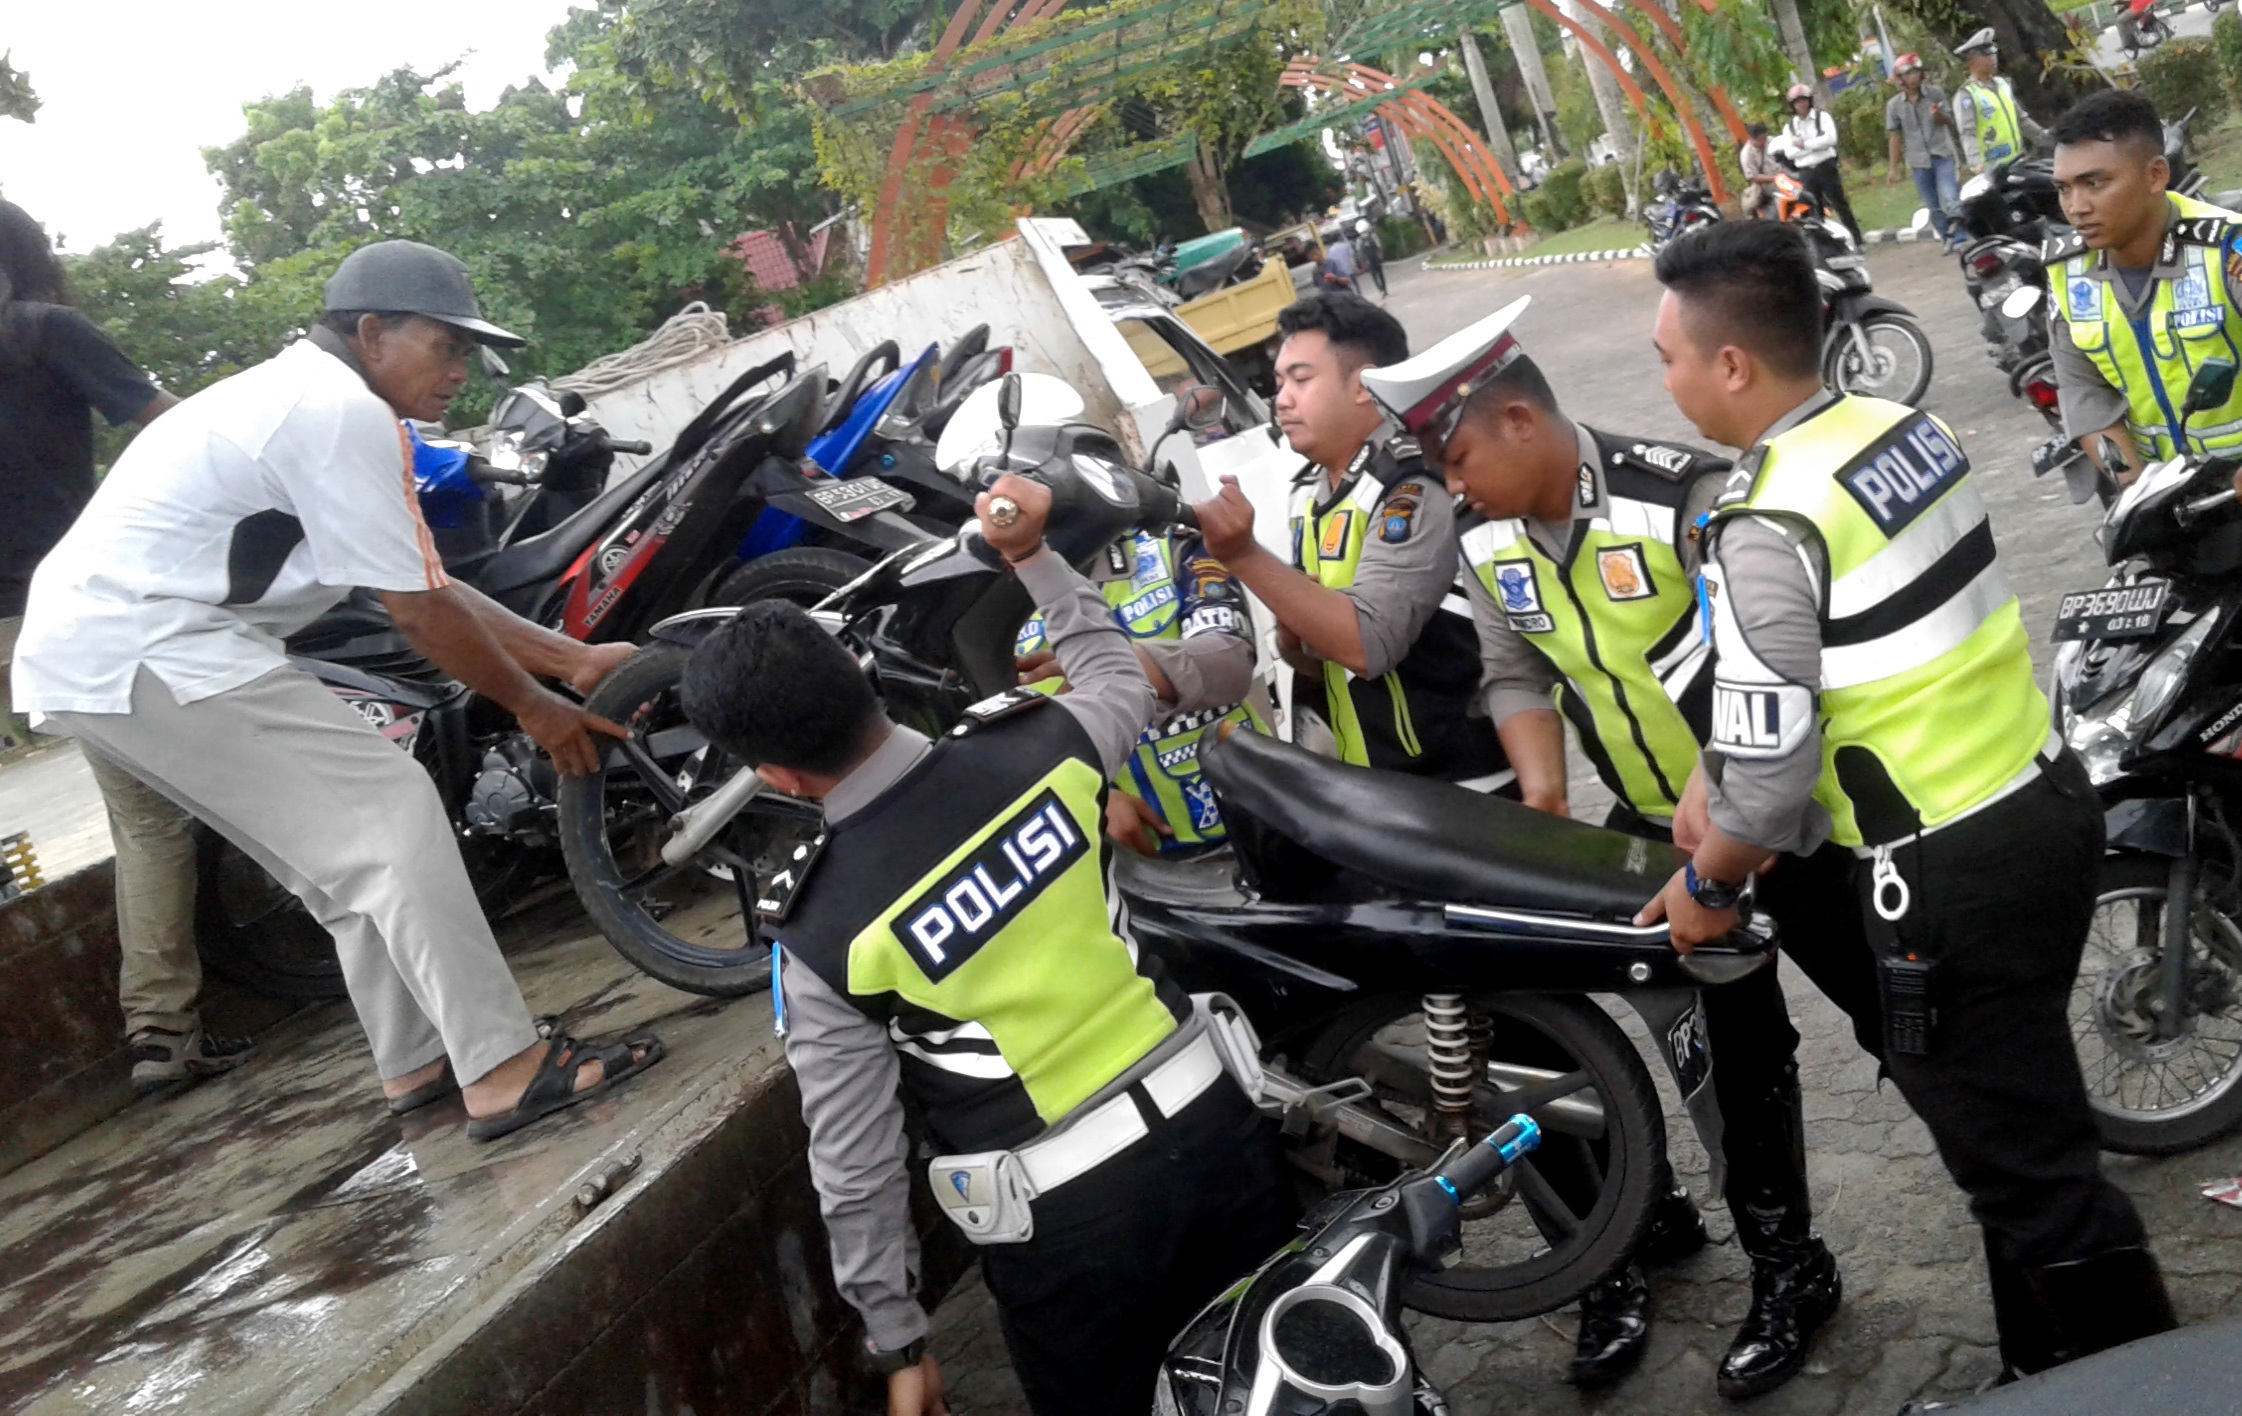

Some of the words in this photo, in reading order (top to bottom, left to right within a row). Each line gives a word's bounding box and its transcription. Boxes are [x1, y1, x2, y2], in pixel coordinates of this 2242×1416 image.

[1848, 417, 1965, 522] POLISI
[584, 587, 621, 626] YAMAHA
[1121, 584, 1175, 622] POLISI
[907, 801, 1078, 966] POLISI
